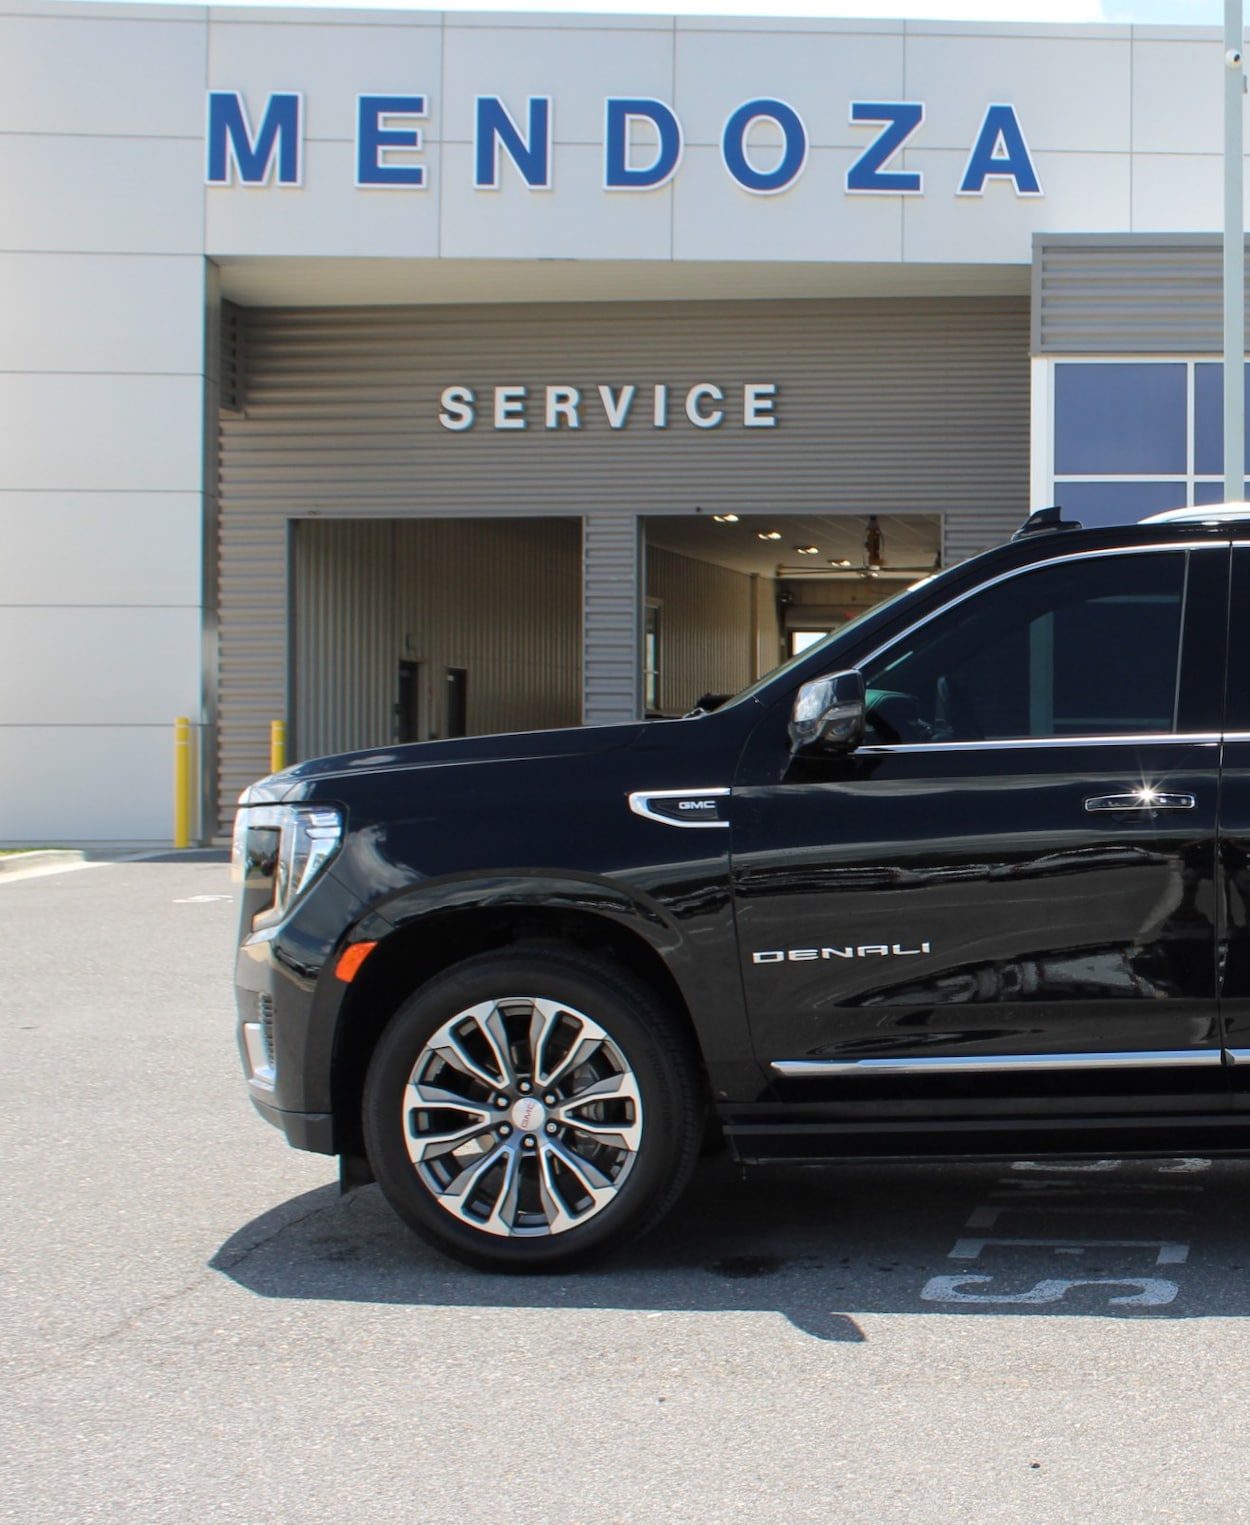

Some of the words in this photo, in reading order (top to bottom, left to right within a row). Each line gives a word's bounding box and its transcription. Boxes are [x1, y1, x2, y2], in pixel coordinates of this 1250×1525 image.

[204, 91, 1045, 197] MENDOZA
[438, 383, 776, 431] SERVICE
[679, 801, 716, 810] GMC
[753, 942, 931, 964] DENALI
